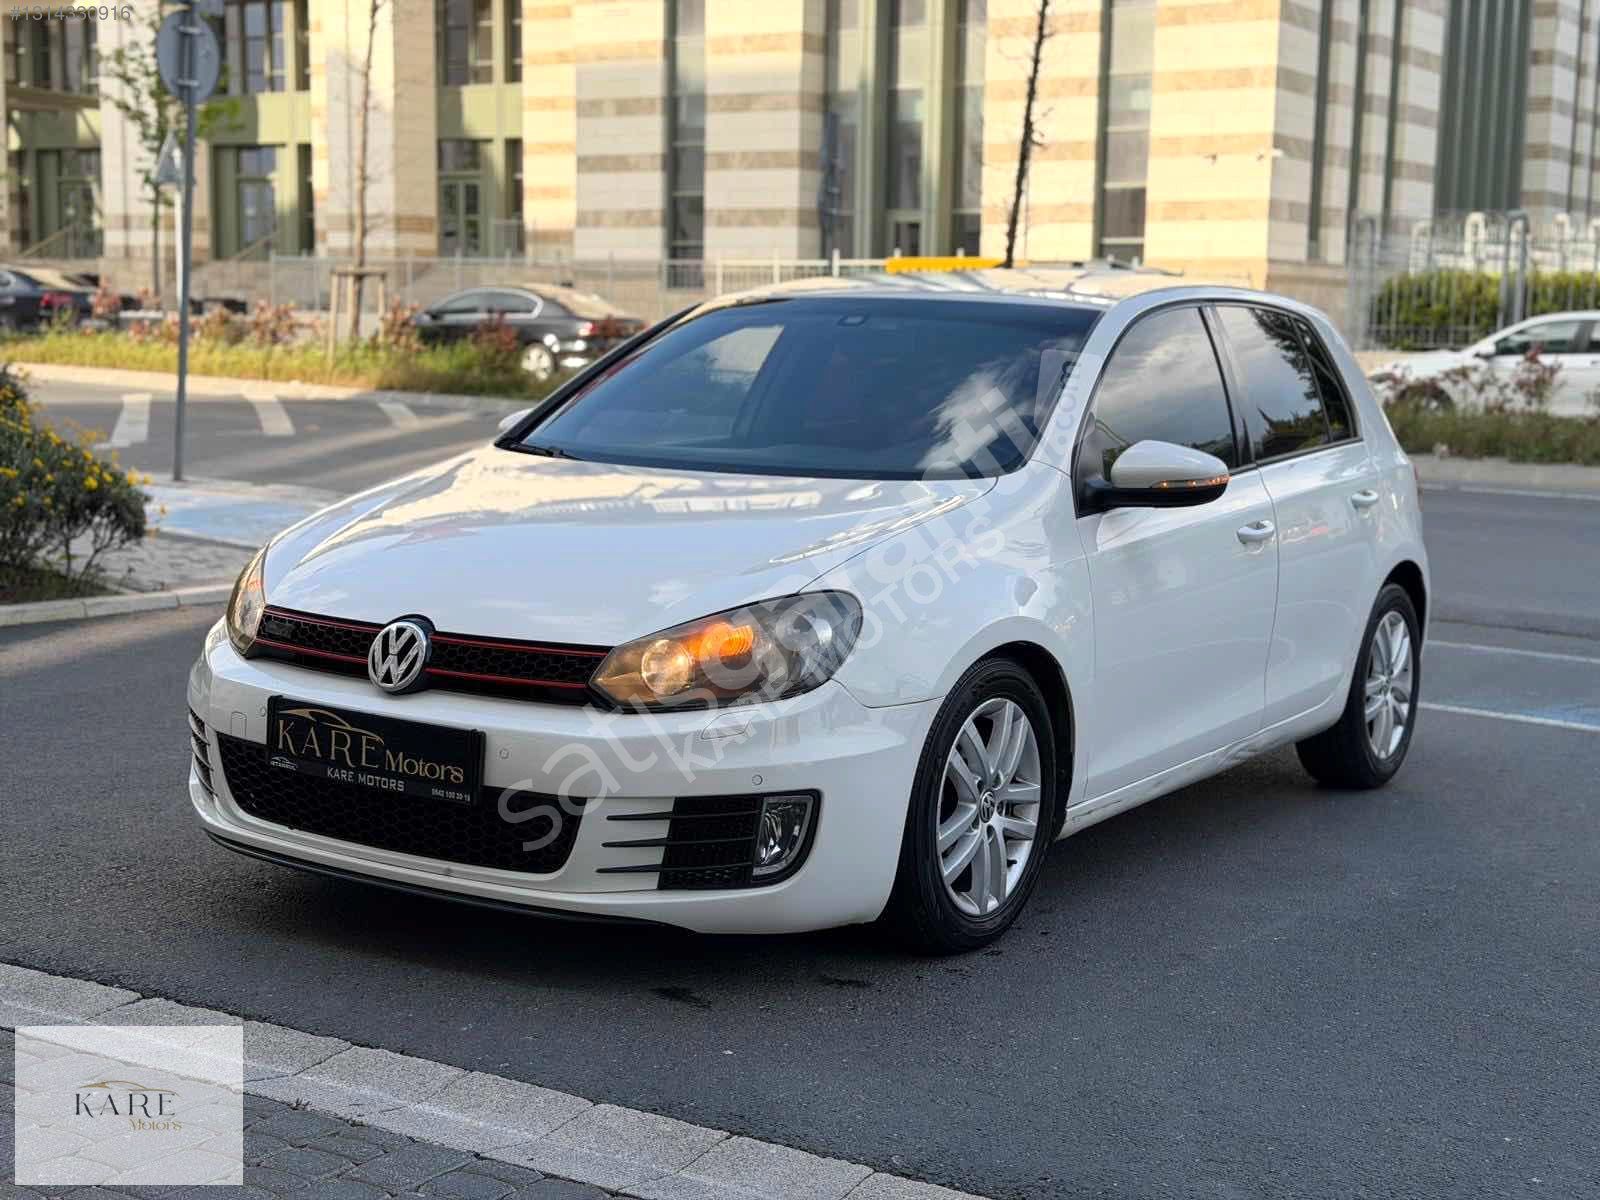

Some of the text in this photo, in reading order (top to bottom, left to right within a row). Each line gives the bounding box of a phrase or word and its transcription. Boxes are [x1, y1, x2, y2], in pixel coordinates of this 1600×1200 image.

[278, 719, 464, 784] KARE Motors
[327, 767, 405, 792] KARE MOTORS
